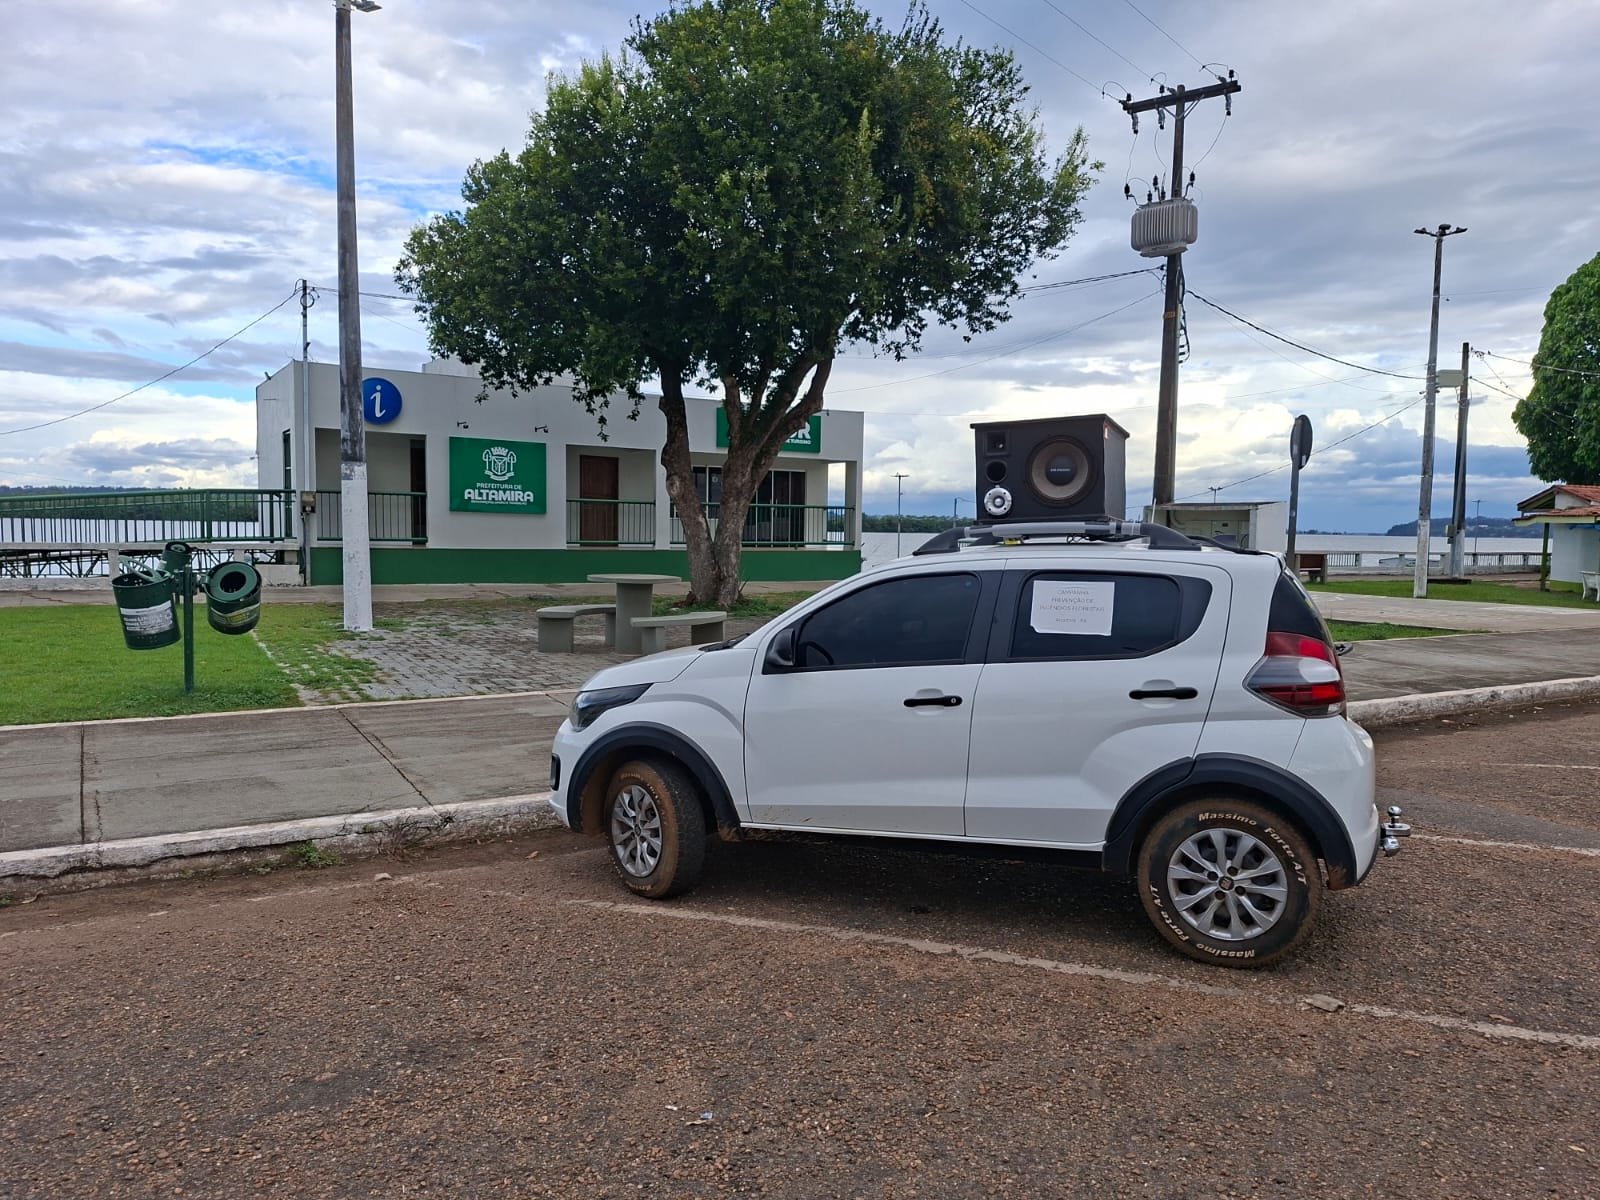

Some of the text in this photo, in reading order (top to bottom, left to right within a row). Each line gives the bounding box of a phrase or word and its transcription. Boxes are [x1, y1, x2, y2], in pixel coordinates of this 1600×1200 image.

[464, 488, 534, 502] ALTAMIRA
[1198, 812, 1257, 826] Massimo
[1264, 827, 1295, 858] Forte
[1161, 910, 1190, 942] Forte
[1196, 943, 1255, 958] Massimo
